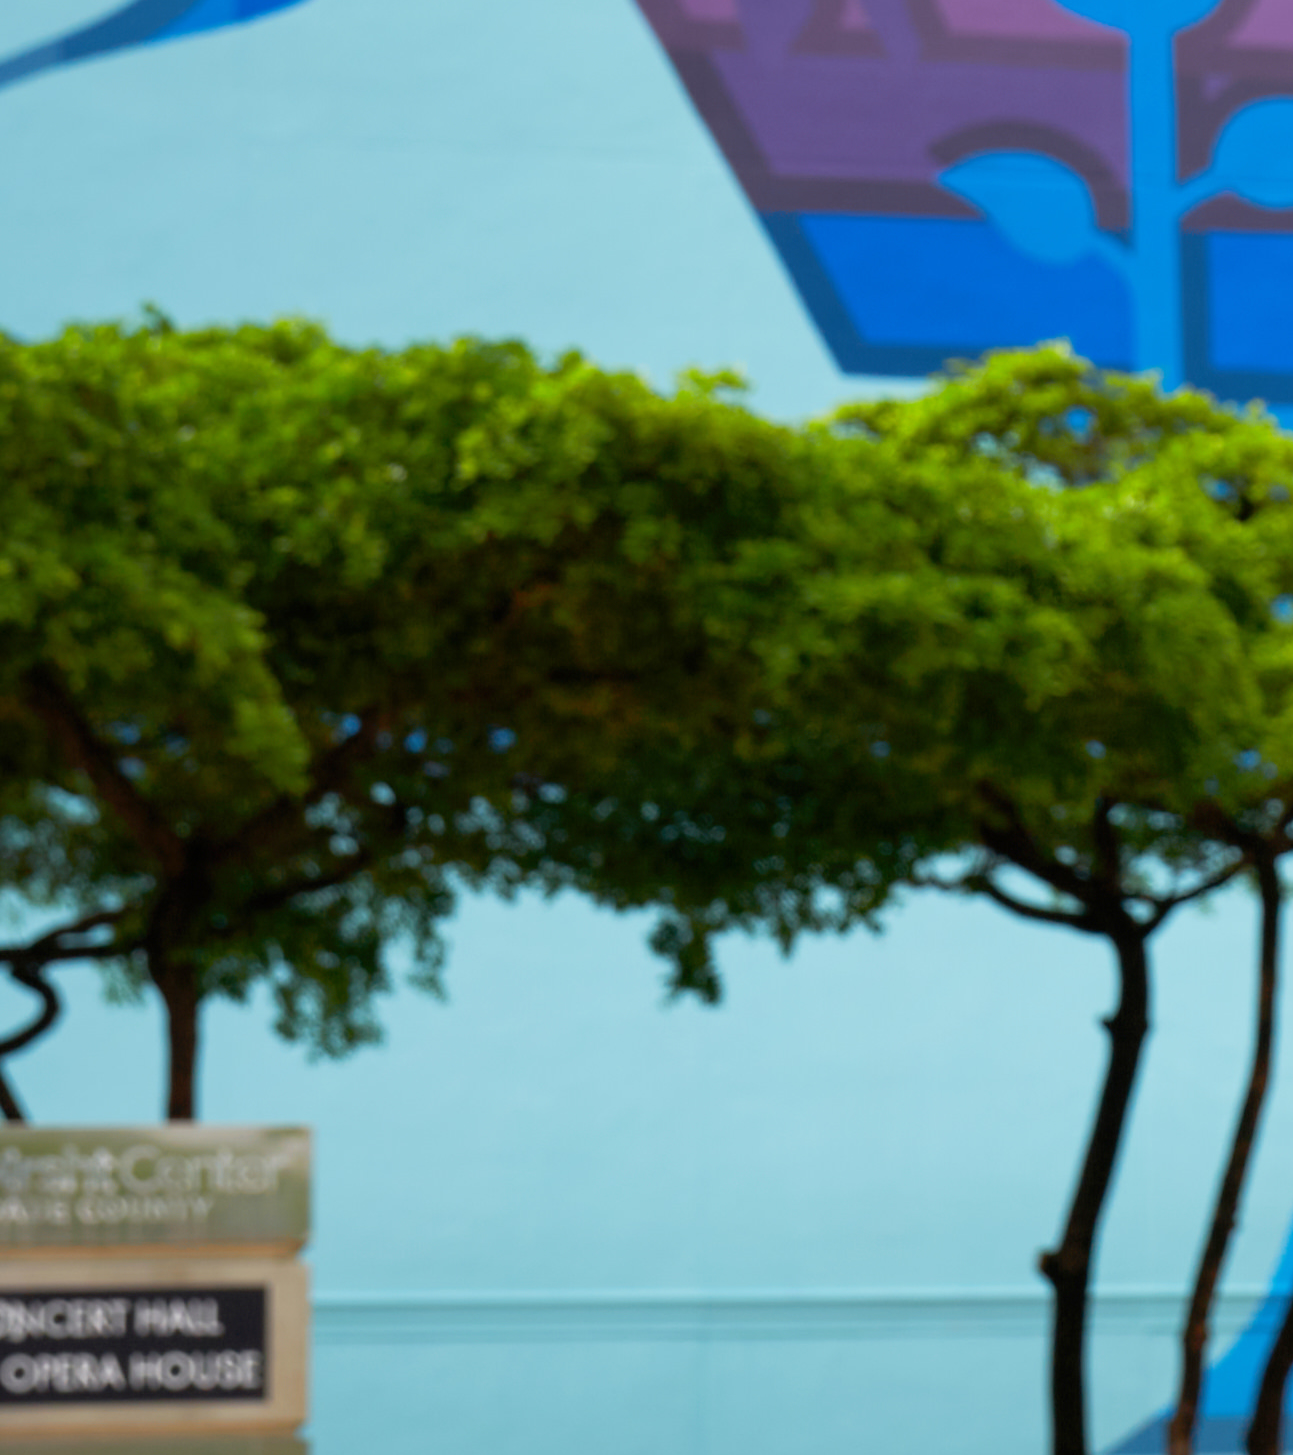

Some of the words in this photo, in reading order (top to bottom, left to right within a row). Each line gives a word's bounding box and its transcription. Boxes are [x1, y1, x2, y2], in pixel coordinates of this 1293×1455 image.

[133, 1296, 226, 1338] HALL
[0, 1351, 127, 1394] OPERA
[128, 1349, 264, 1391] HOUSE
